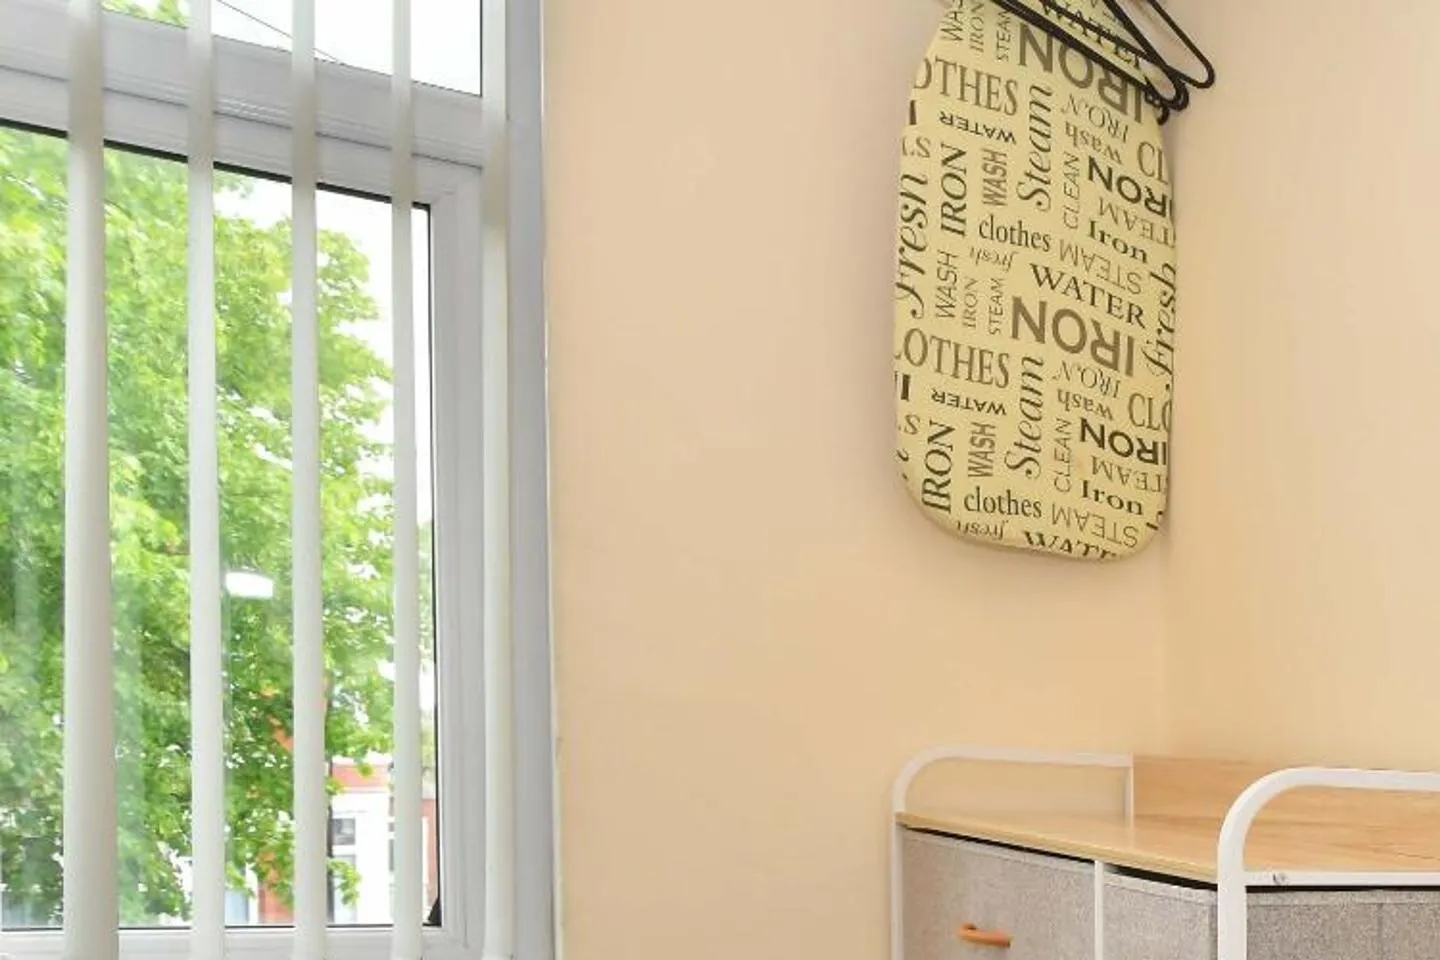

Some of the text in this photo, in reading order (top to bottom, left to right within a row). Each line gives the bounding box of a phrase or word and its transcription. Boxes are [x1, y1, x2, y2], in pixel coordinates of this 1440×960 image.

[938, 110, 1017, 145] WATER
[1015, 84, 1052, 212] Steam
[1065, 121, 1122, 165] wash
[940, 142, 967, 237] IRON
[981, 147, 1008, 207] WASH
[1063, 151, 1080, 230] CLEAN
[978, 213, 1051, 252] clothes
[1087, 220, 1149, 264] Iron
[935, 249, 961, 319] WASH
[1059, 239, 1143, 295] STEAM
[962, 276, 979, 329] IRON
[988, 277, 1006, 336] STEAM
[1029, 262, 1147, 330] WATER
[1010, 295, 1136, 378] IRON
[931, 388, 1007, 416] WATER
[1003, 356, 1045, 481] Steam
[1057, 388, 1114, 421] wash
[921, 417, 956, 514] IRON
[967, 421, 997, 478] WASH
[1053, 417, 1073, 493] CLEAN
[1079, 417, 1168, 467] IRON
[963, 485, 1043, 519] clothes
[1082, 479, 1144, 516] Iron
[1051, 503, 1140, 549] STEAM
